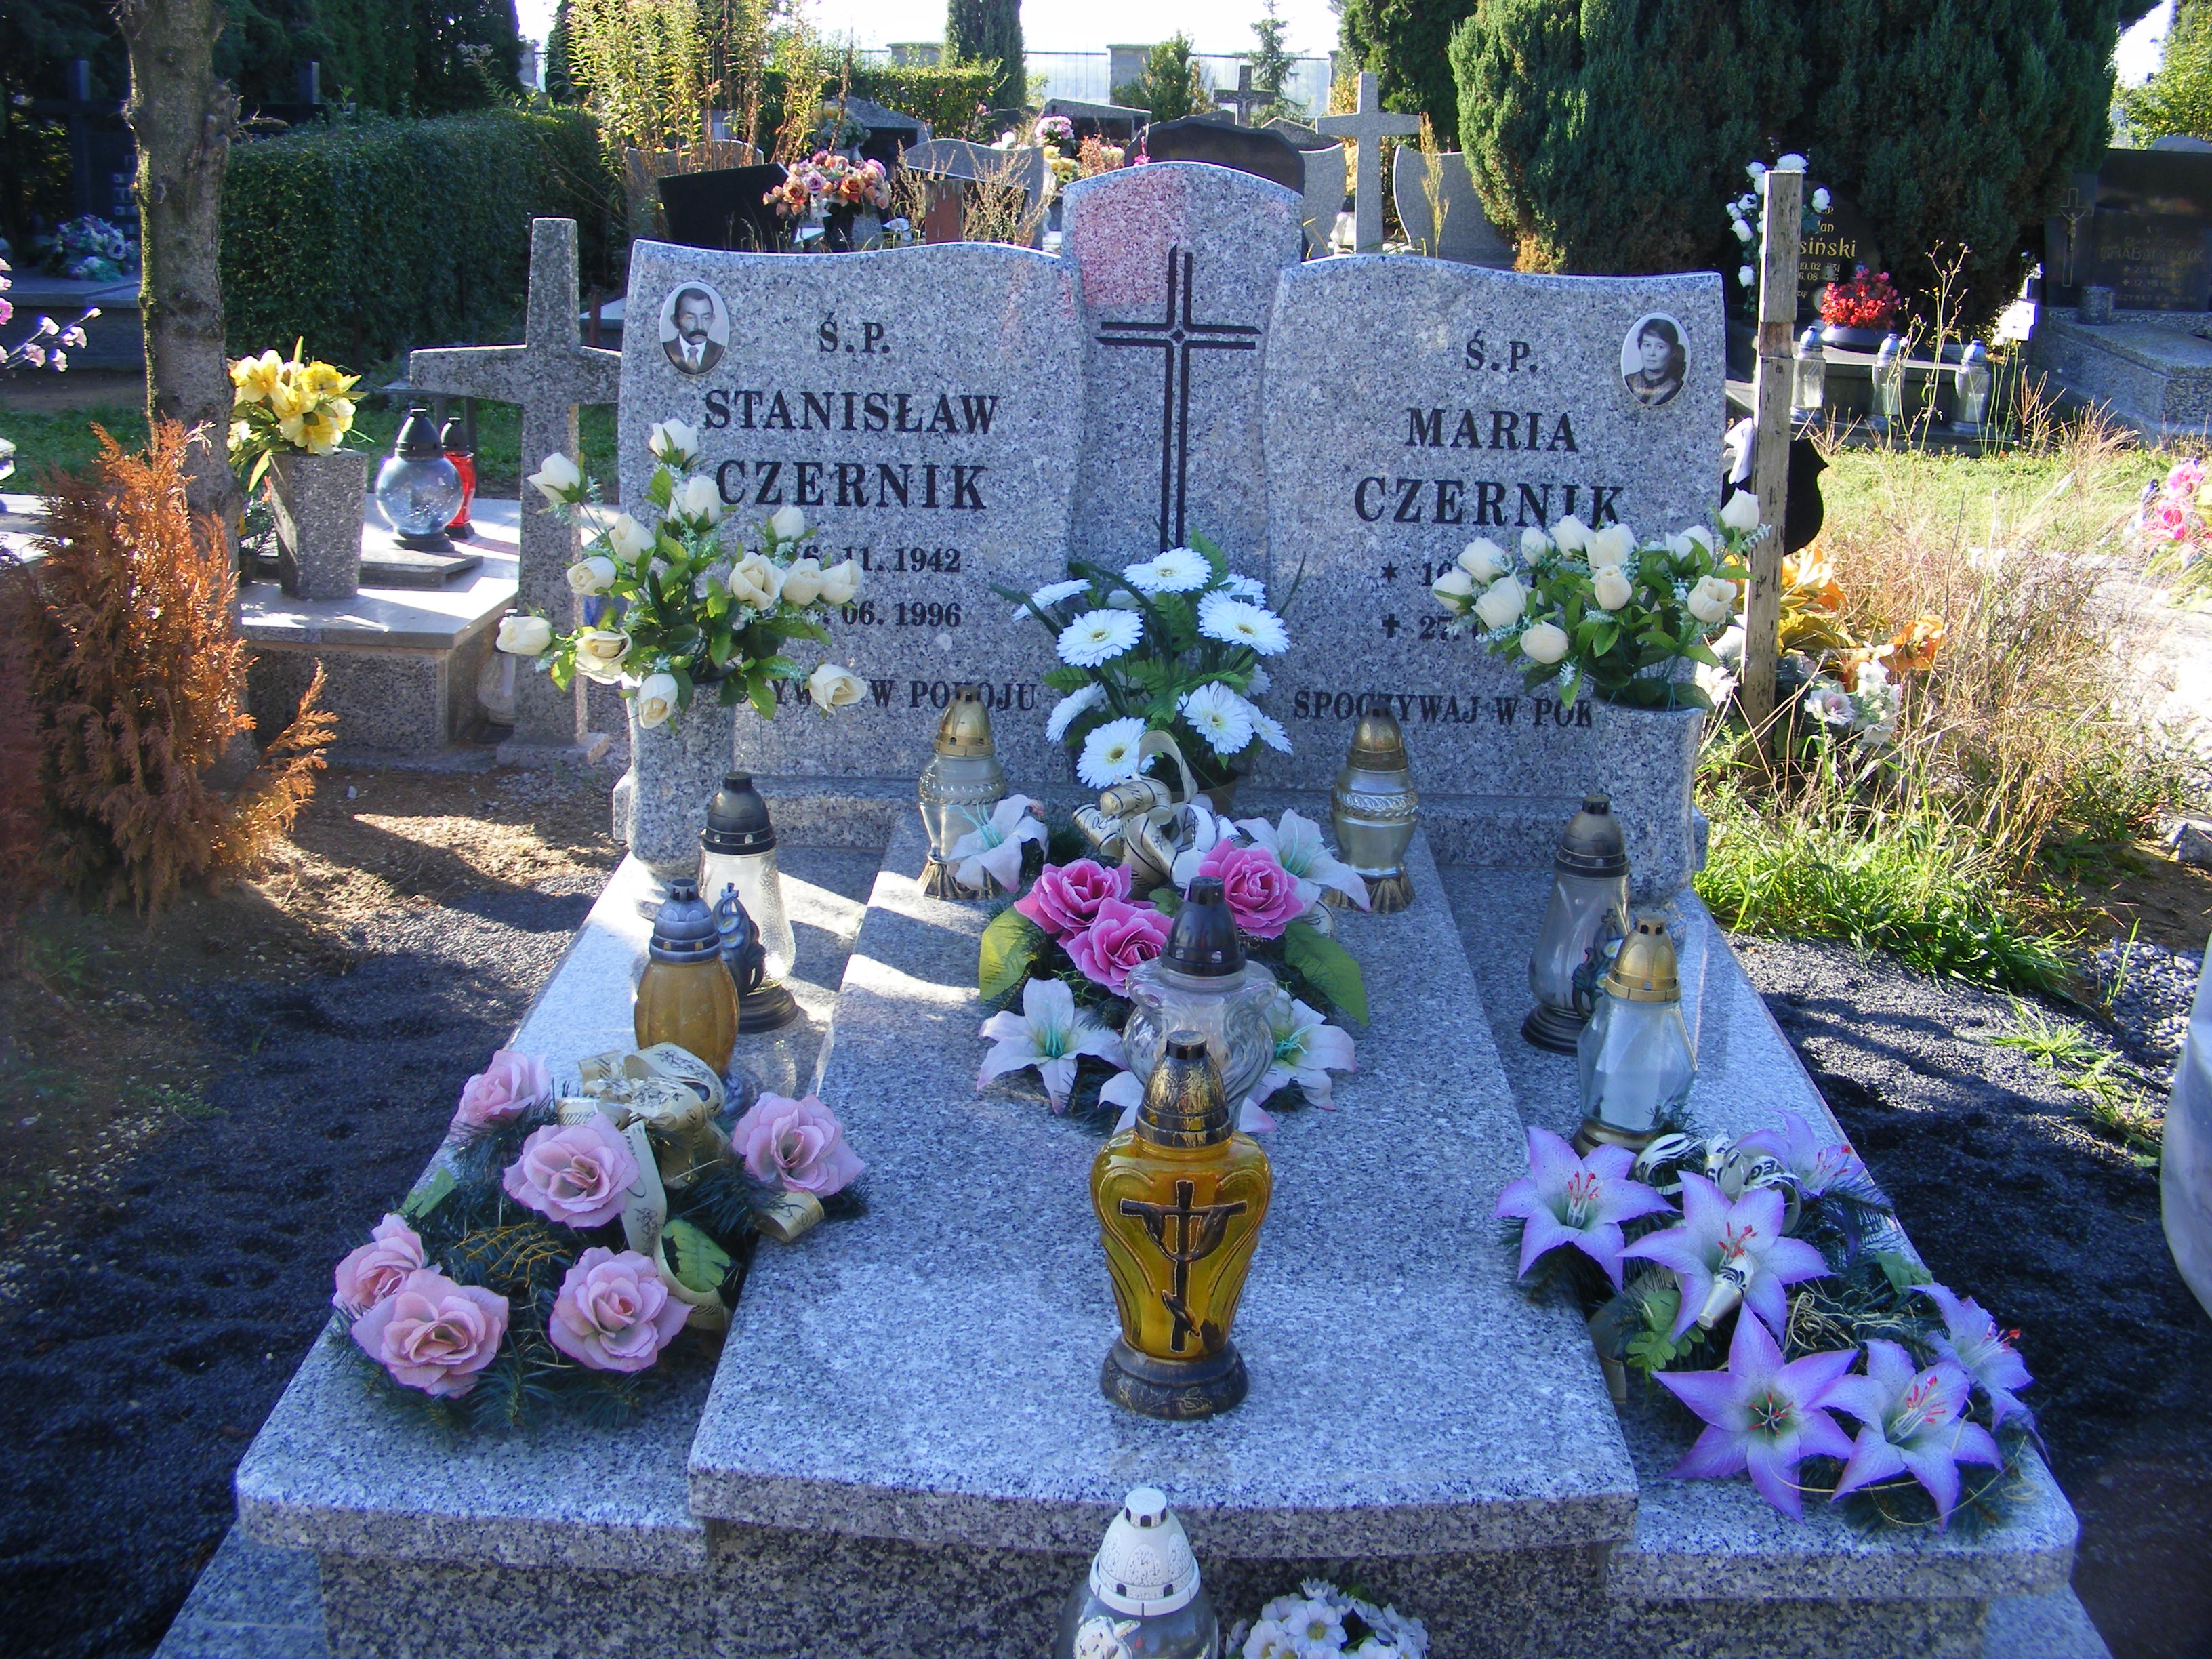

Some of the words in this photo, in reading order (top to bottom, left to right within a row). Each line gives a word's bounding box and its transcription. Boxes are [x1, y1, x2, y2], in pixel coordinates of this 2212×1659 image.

[1799, 237, 1856, 258] siński
[703, 388, 999, 435] STANISŁAW
[1405, 407, 1580, 453] MARIA
[716, 459, 988, 510] CZERNIK
[1355, 476, 1624, 529] CZERNIK
[870, 679, 895, 708] W
[909, 680, 1038, 712] POOJU
[1494, 697, 1519, 726] W
[1532, 697, 1593, 728] POK
